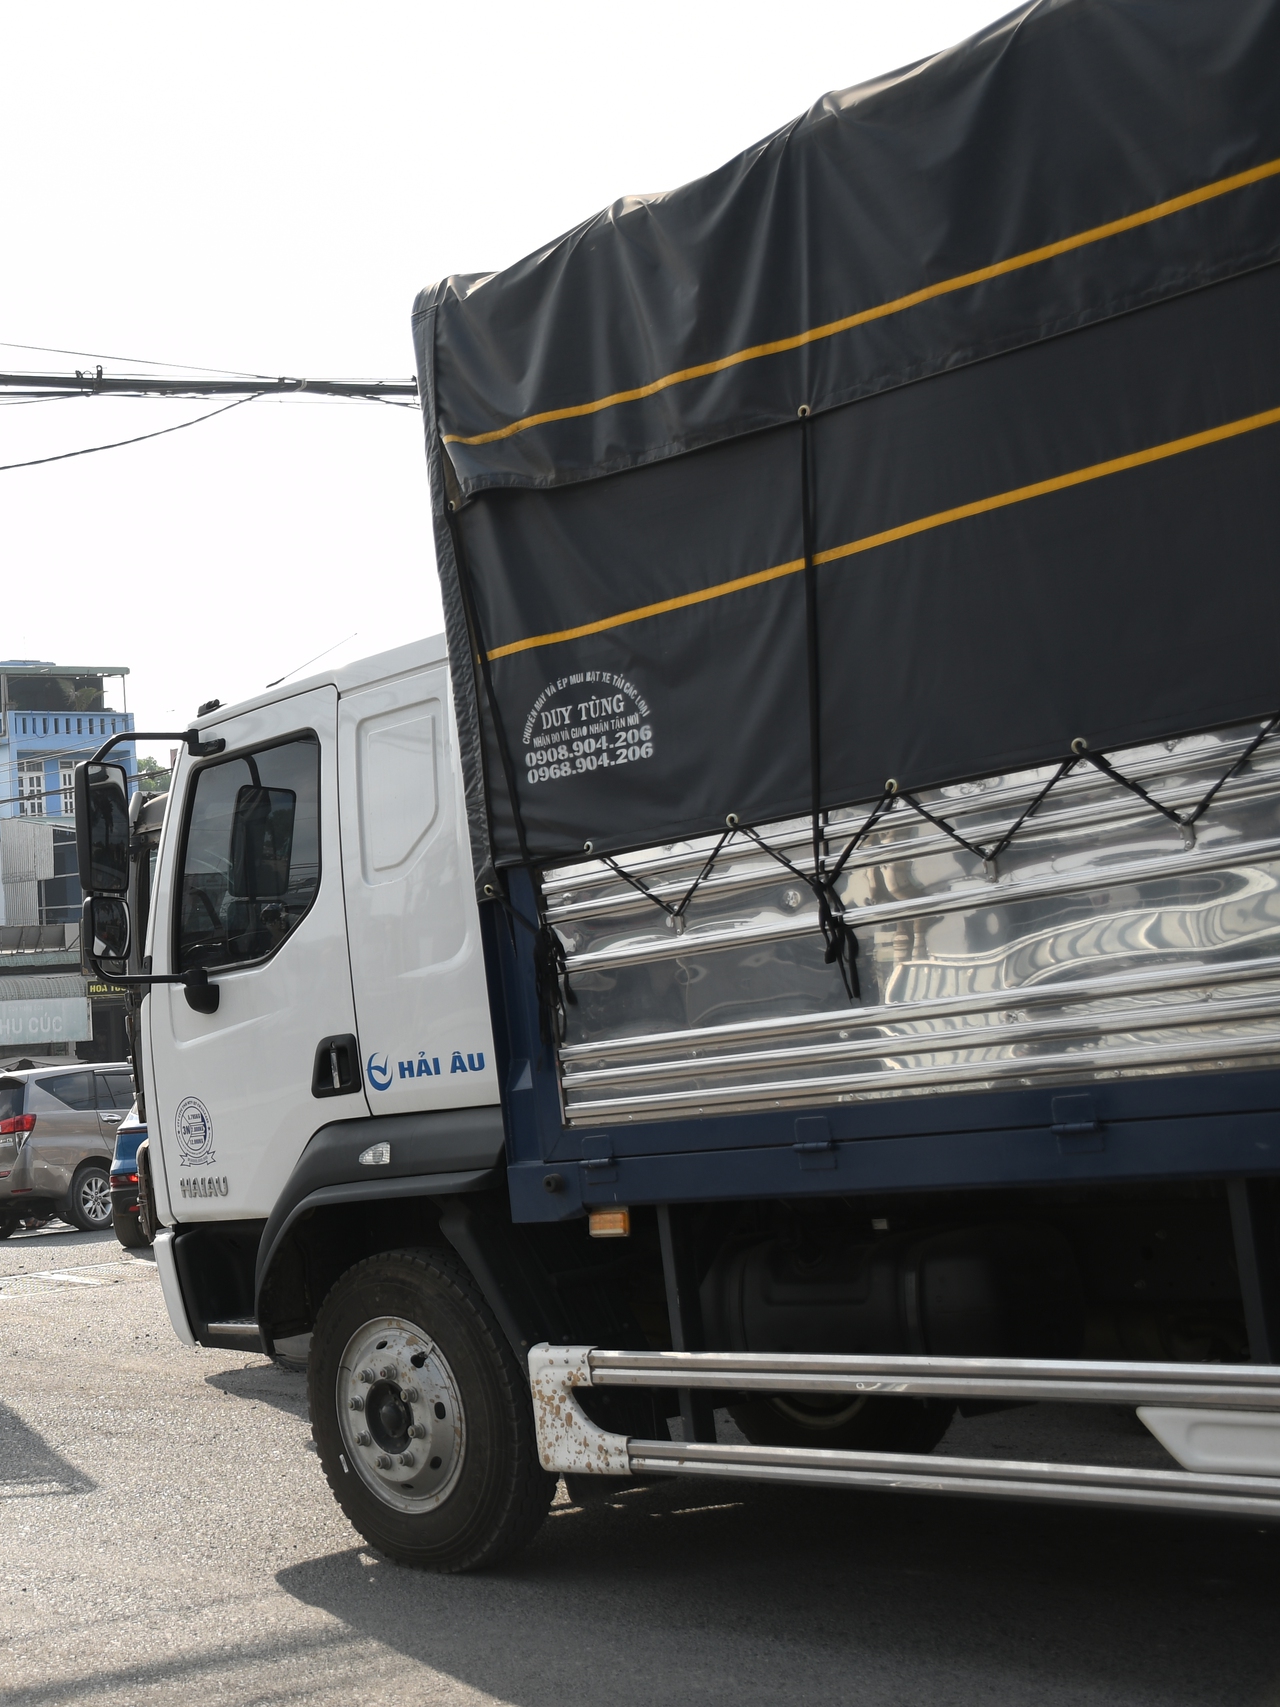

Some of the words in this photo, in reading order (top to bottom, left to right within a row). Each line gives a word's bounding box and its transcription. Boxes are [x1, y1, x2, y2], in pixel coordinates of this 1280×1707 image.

[534, 692, 547, 711] MAY
[544, 683, 557, 697] VÀ
[556, 677, 568, 690] ÉP
[569, 673, 584, 686] MUI
[586, 671, 600, 684] BẠT
[602, 672, 612, 684] XE
[613, 674, 625, 689] TẢI
[623, 682, 637, 700] CÁC
[635, 695, 651, 718] LOẠI
[540, 705, 573, 730] DUY
[577, 694, 625, 721] TÙNG
[525, 725, 653, 767] 0908.904.206
[533, 734, 551, 749] NHẬN
[560, 727, 570, 741] VÀ
[570, 726, 588, 739] GIAO
[589, 719, 609, 736] NHẬN
[610, 716, 626, 731] TẬN
[527, 742, 654, 784] 0968.904.206
[28, 1012, 63, 1033] CÚC
[398, 1051, 441, 1079] HẢI
[450, 1051, 486, 1074] ÂU
[180, 1175, 229, 1199] HAIAU
